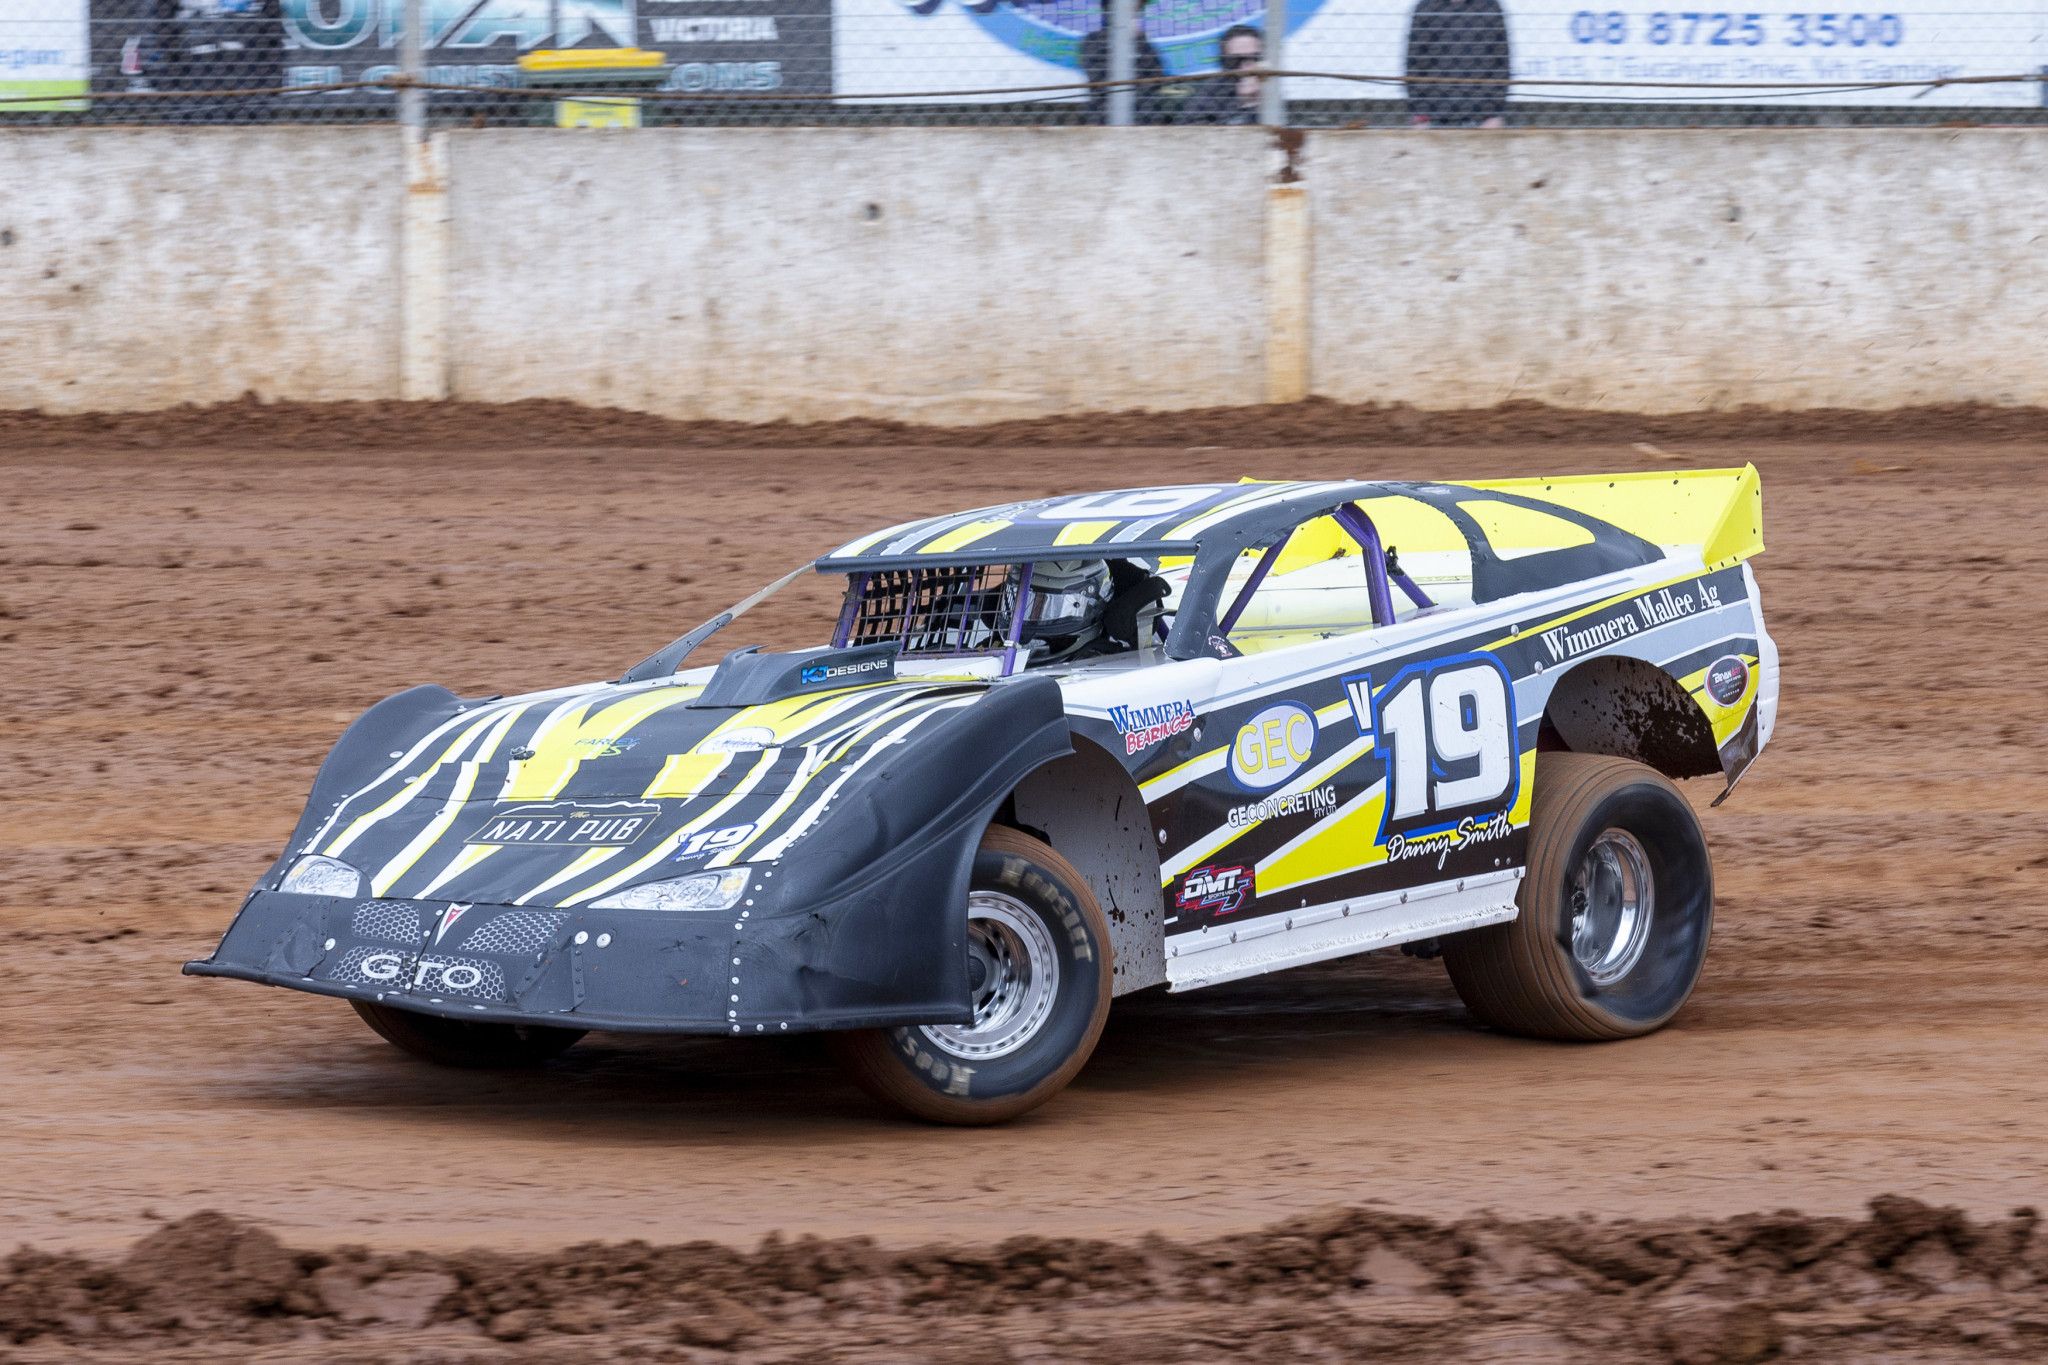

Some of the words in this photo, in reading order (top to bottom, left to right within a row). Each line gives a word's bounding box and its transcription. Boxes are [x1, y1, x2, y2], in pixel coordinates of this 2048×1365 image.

[649, 16, 779, 42] VICTORIA
[1571, 11, 1627, 45] 08
[1649, 11, 1766, 47] 8725
[1783, 12, 1903, 48] 3500
[1540, 626, 1639, 663] Wimmera
[1633, 588, 1696, 629] Mallee
[1696, 578, 1723, 614] Ag
[827, 658, 888, 677] DESIGNS
[1107, 699, 1195, 733] WIMMERA
[1125, 711, 1192, 755] BEARINGS
[1235, 713, 1312, 774] GEC
[1382, 664, 1511, 821] 19
[482, 818, 566, 842] NATI
[568, 816, 643, 841] PUB
[1313, 807, 1326, 819] PTY
[1325, 804, 1338, 817] LTD
[682, 824, 755, 855] 19
[1387, 833, 1452, 870] Danny
[1454, 810, 1513, 851] Smith
[360, 953, 483, 990] GTO
